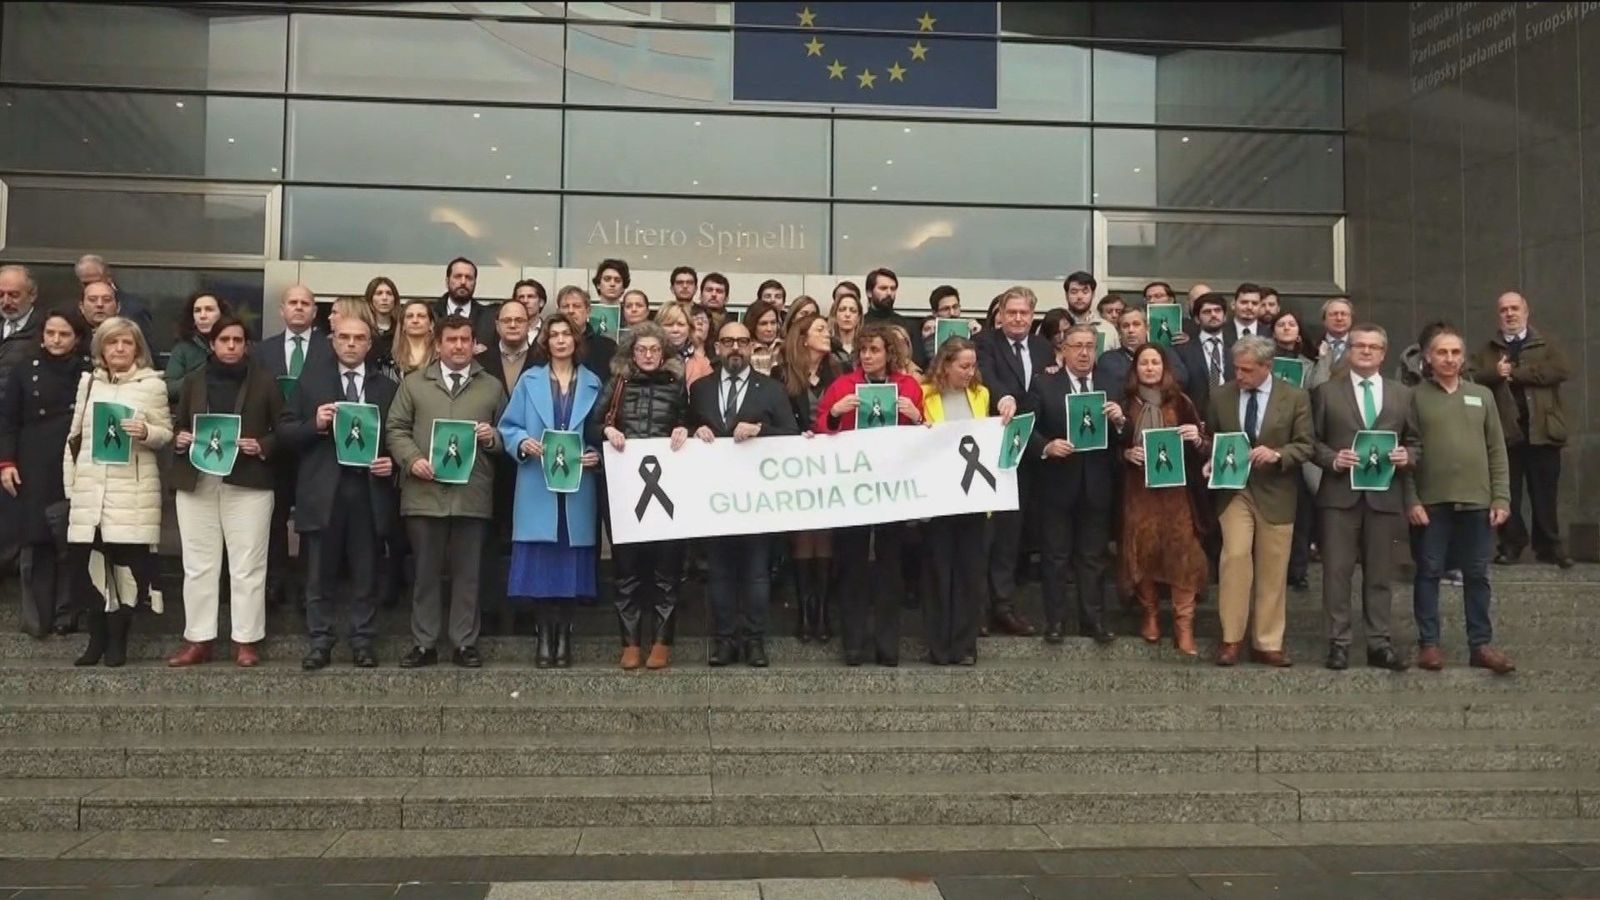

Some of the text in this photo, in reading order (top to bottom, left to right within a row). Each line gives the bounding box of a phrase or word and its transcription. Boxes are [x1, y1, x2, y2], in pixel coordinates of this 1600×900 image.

[1460, 32, 1517, 73] parlament
[588, 220, 805, 255] Altiero Spinelli
[759, 450, 872, 480] CON LA
[709, 479, 928, 514] GUARDIA CIVIL
